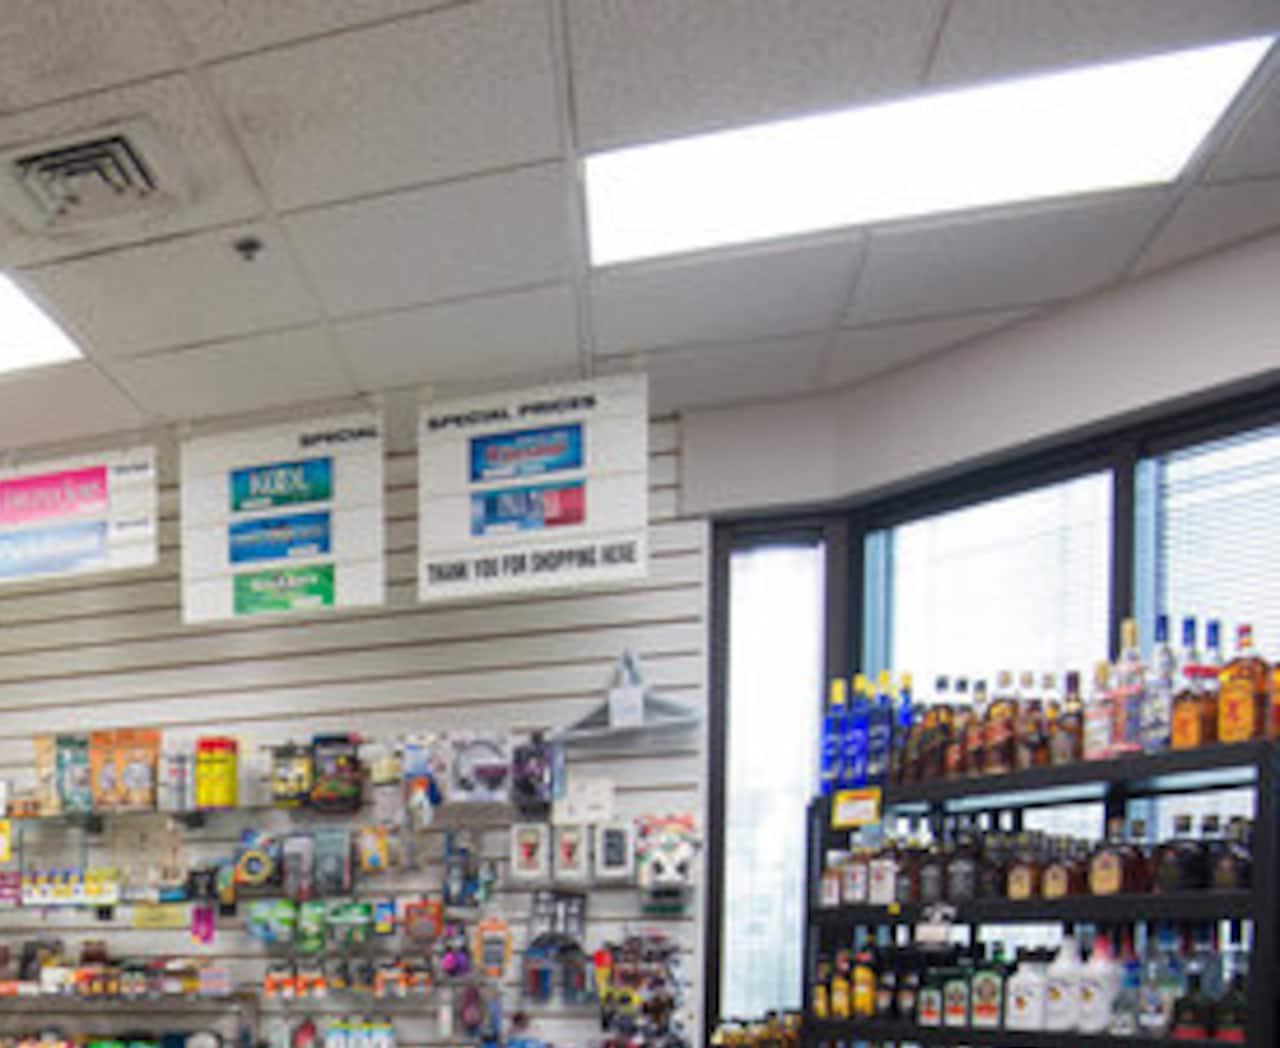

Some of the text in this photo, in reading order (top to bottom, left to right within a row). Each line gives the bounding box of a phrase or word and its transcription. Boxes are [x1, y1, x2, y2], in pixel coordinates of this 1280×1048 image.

[428, 395, 597, 431] SPECIAL PRICES
[427, 561, 468, 584] THANK
[474, 557, 498, 579] YOU
[502, 553, 526, 575] FOR
[530, 545, 598, 573] SHOPPING
